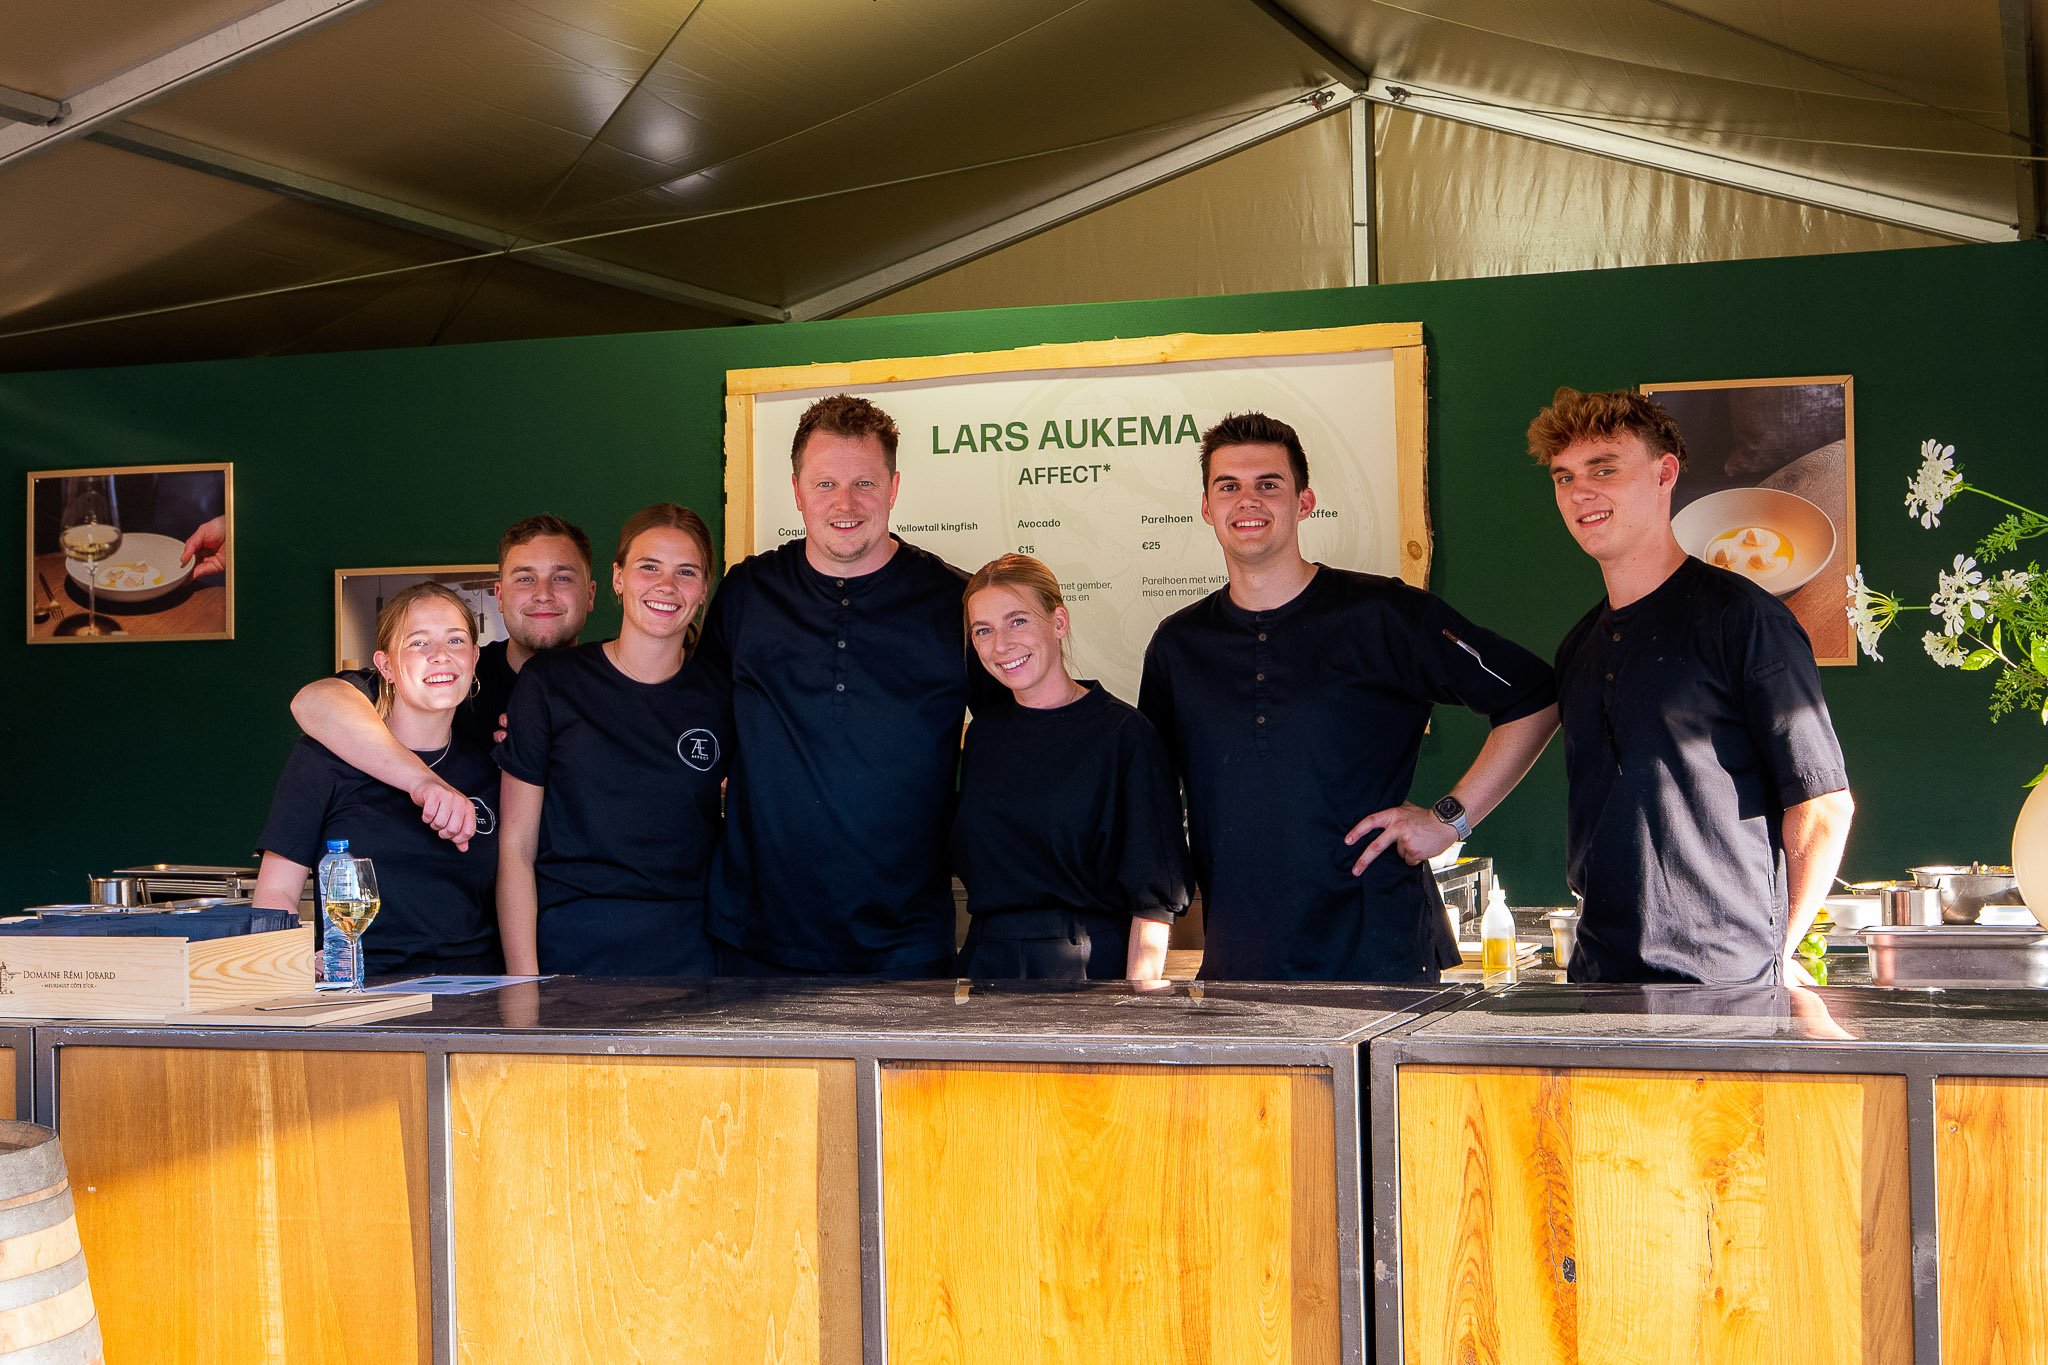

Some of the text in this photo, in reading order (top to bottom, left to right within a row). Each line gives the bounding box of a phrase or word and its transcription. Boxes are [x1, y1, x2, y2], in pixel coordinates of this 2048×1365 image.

[932, 414, 1201, 454] LARS AUKEMA
[1310, 509, 1338, 519] offee
[1017, 518, 1061, 529] Avocado
[1141, 515, 1193, 524] Parelhoen
[896, 522, 978, 533] Yellowtail kingfish
[1017, 545, 1035, 554] €15
[1142, 541, 1161, 550] €25
[1142, 576, 1187, 586] Parelhoen
[1188, 575, 1206, 584] met
[1077, 581, 1113, 592] gember,
[1063, 594, 1077, 602] ras
[1142, 589, 1164, 597] miso
[1165, 589, 1177, 597] en
